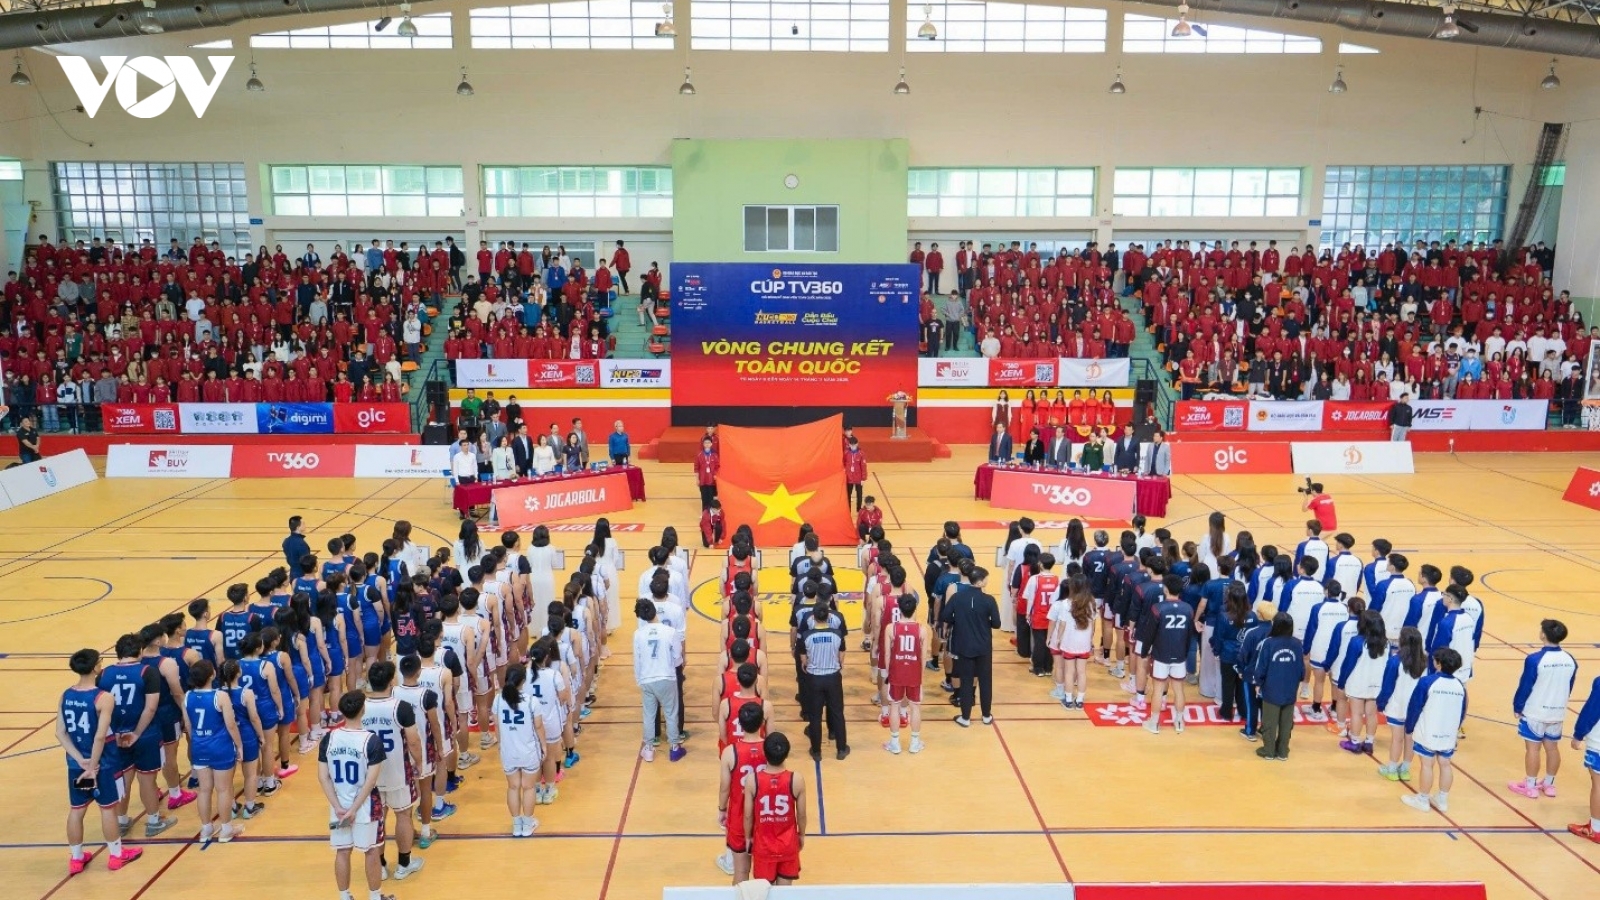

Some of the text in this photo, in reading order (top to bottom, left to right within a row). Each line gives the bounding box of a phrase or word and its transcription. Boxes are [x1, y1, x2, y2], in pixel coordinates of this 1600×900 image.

[751, 279, 843, 295] CÚP TV360
[701, 338, 894, 356] VÒNG CHUNG KẾT
[541, 370, 563, 379] XEM
[735, 358, 861, 375] TOÀN QUỐC
[951, 369, 969, 377] BUV
[1001, 369, 1023, 378] XEM
[116, 416, 141, 425] XEM
[1187, 412, 1211, 422] XEM
[1344, 410, 1389, 421] JOGARBOLA
[1411, 408, 1457, 419] MSE
[267, 452, 320, 470] TV360
[544, 487, 606, 511] JOGARBOLA
[1032, 482, 1092, 507] TV360
[1165, 615, 1187, 629] 22
[648, 639, 658, 658] 7
[899, 635, 916, 652] 10
[110, 683, 137, 706] 47
[532, 684, 543, 698] 1
[64, 709, 91, 734] 34
[195, 708, 206, 730] 7
[502, 709, 525, 725] 12
[333, 759, 359, 785] 10
[759, 794, 790, 816] 15
